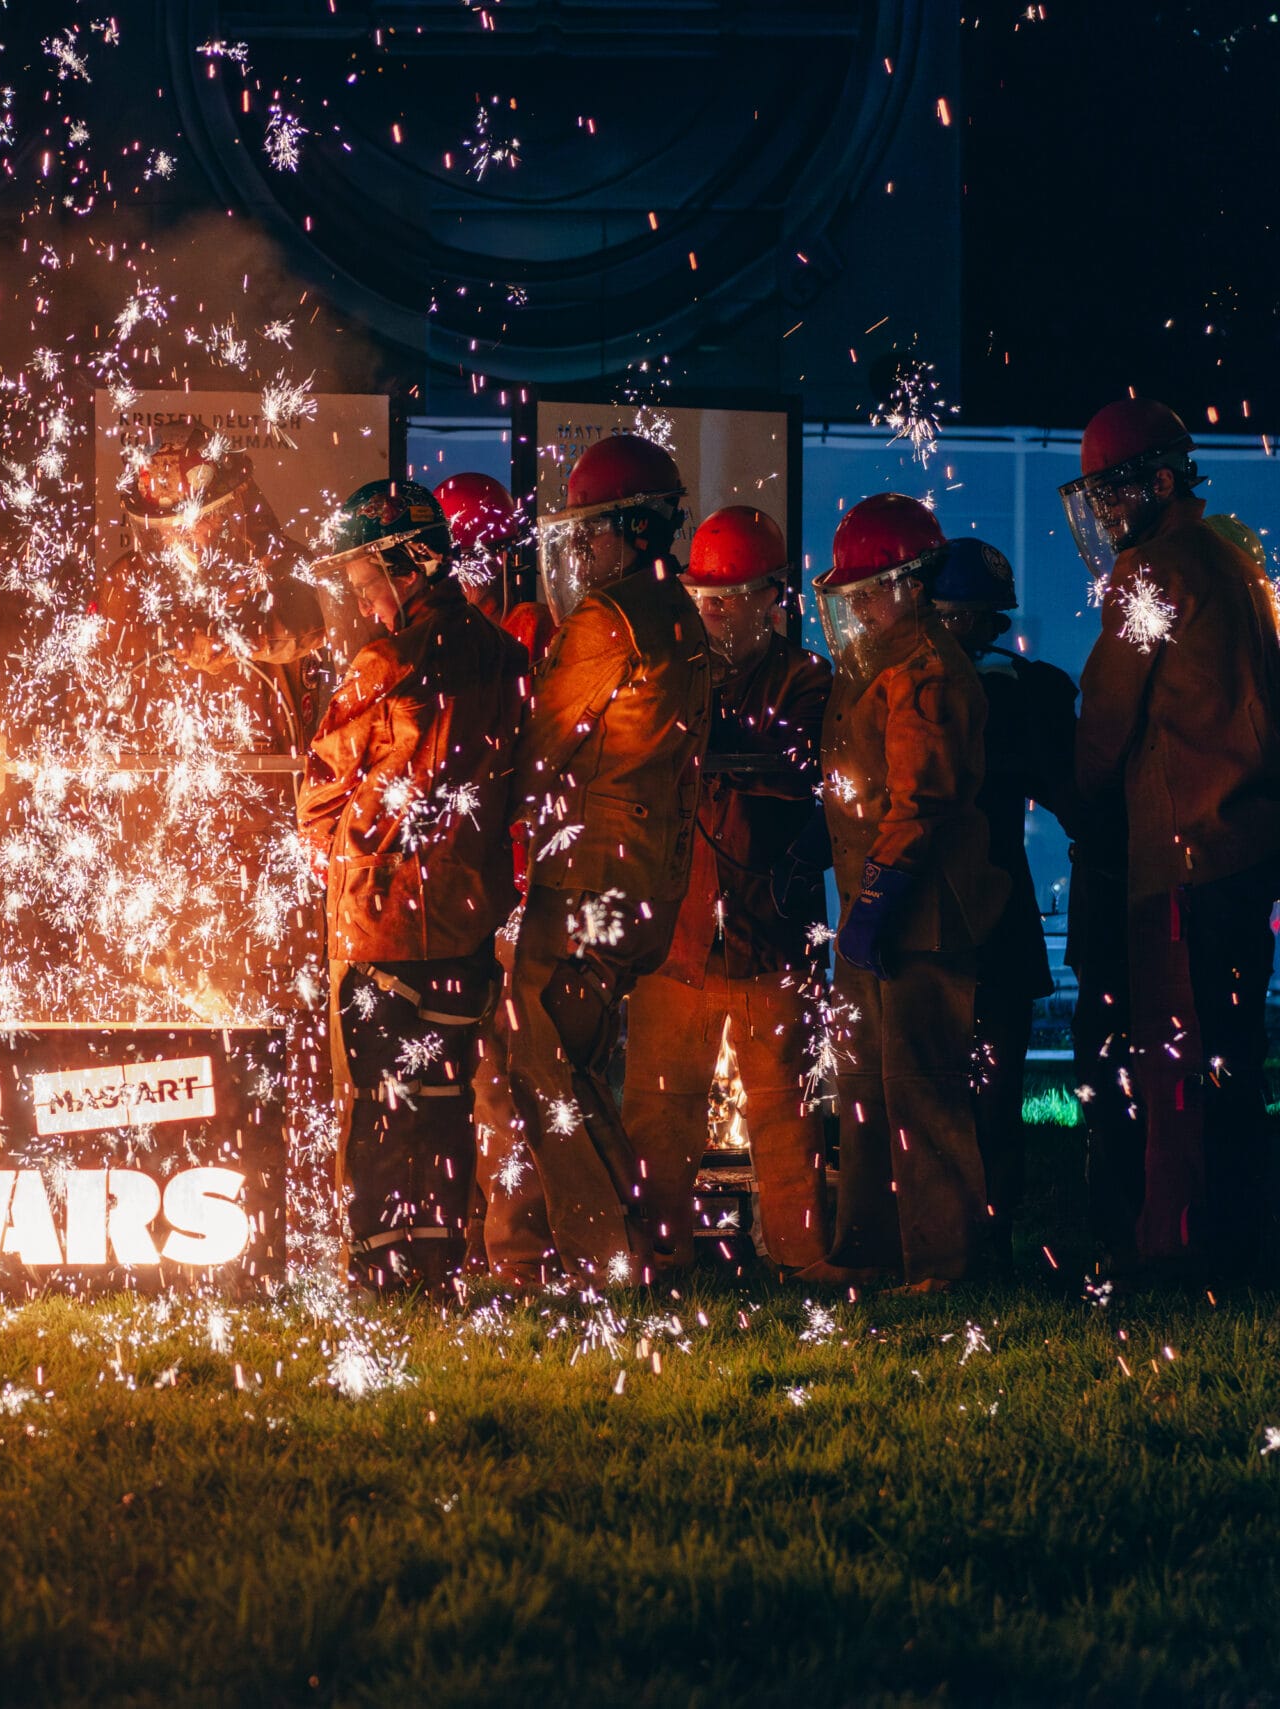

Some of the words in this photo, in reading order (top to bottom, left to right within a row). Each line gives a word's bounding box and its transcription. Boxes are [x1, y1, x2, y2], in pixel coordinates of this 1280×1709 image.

[213, 413, 302, 430] DEUTCH
[557, 424, 602, 439] MATT
[48, 1076, 199, 1115] MASART
